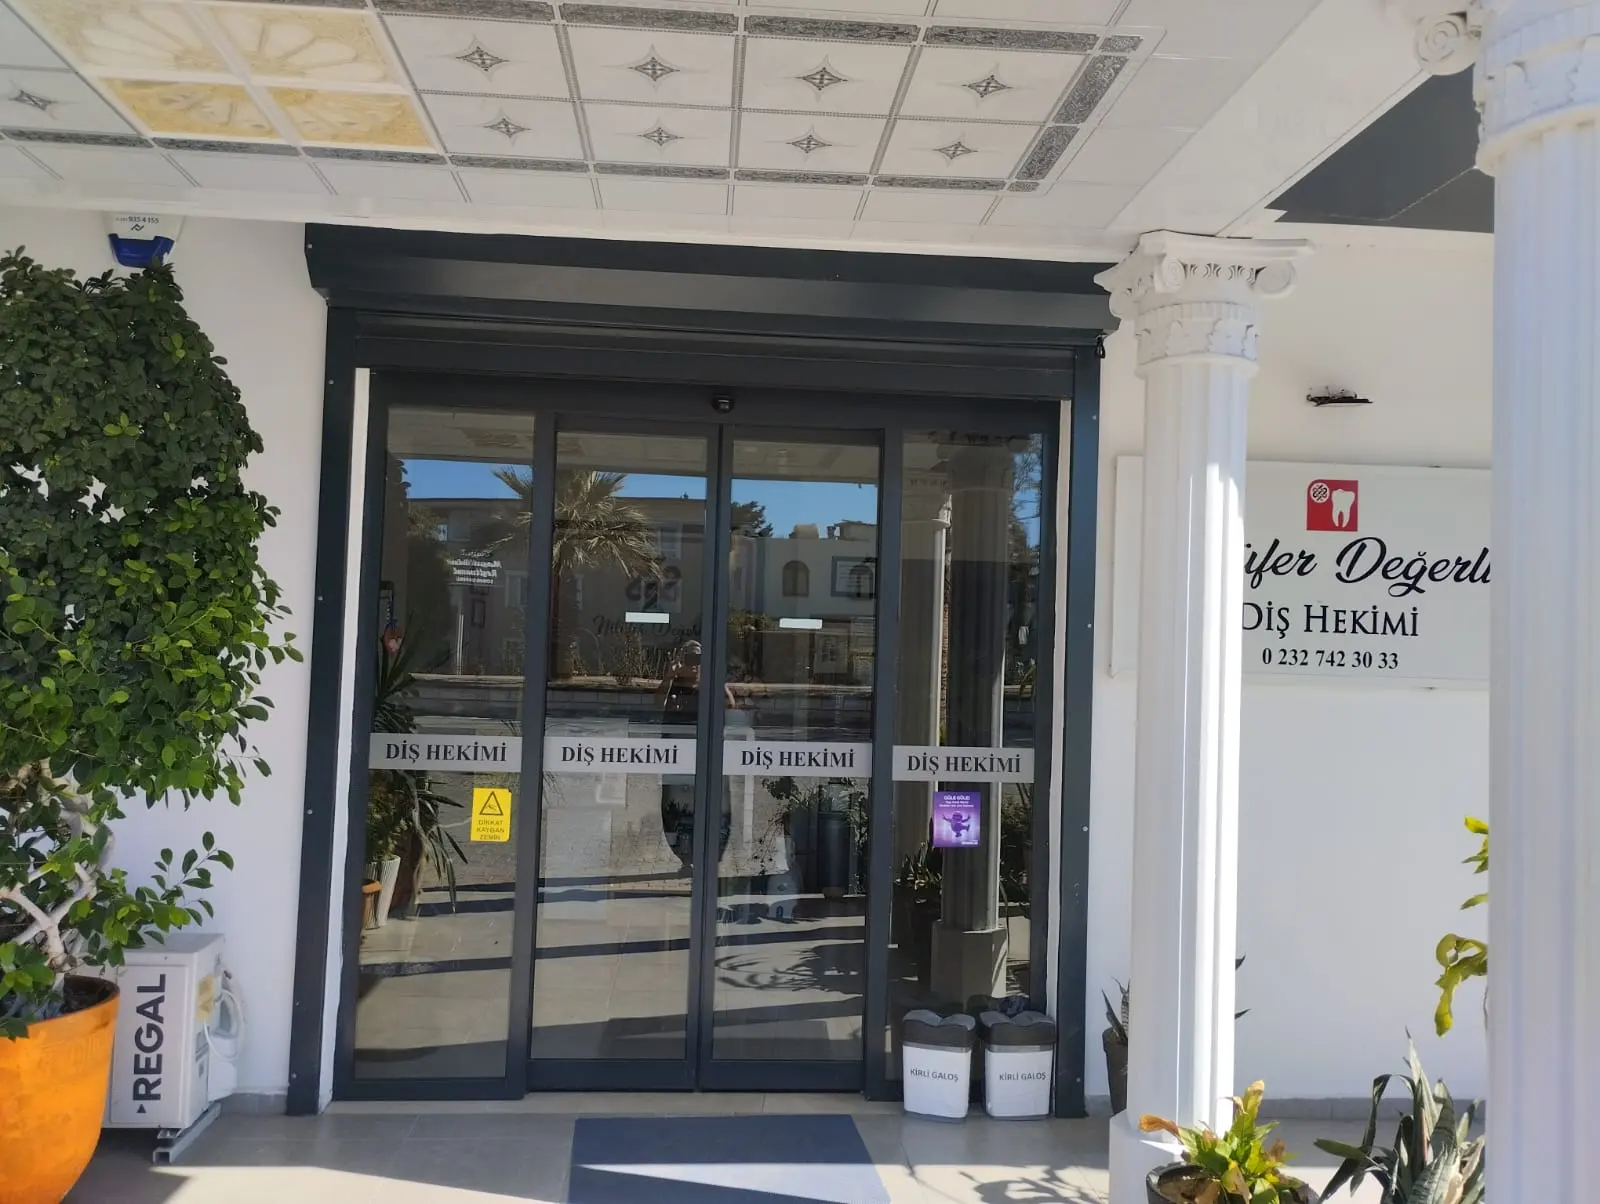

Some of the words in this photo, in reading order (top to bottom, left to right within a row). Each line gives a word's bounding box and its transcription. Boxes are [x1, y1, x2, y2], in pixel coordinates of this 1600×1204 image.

[1242, 601, 1290, 639] DİŞ
[1262, 648, 1272, 665] 0
[1278, 649, 1308, 666] 232
[1316, 650, 1346, 668] 742
[1352, 651, 1372, 669] 30
[1378, 652, 1399, 669] 33
[386, 740, 420, 764] DİŞ
[426, 741, 508, 762] HEKİMİ
[561, 743, 594, 767] DİŞ
[600, 744, 679, 765] HEKİMİ
[741, 747, 773, 770] DİŞ
[779, 748, 855, 769] HEKİMİ
[907, 752, 939, 775] DİŞ
[945, 753, 1022, 773] HEKİMİ
[133, 974, 166, 1101] REGAL
[910, 1068, 930, 1078] KİRLİ
[931, 1071, 959, 1083] GALOŞ
[999, 1072, 1019, 1081] KİRLİ
[1020, 1071, 1047, 1081] GALOŞ
